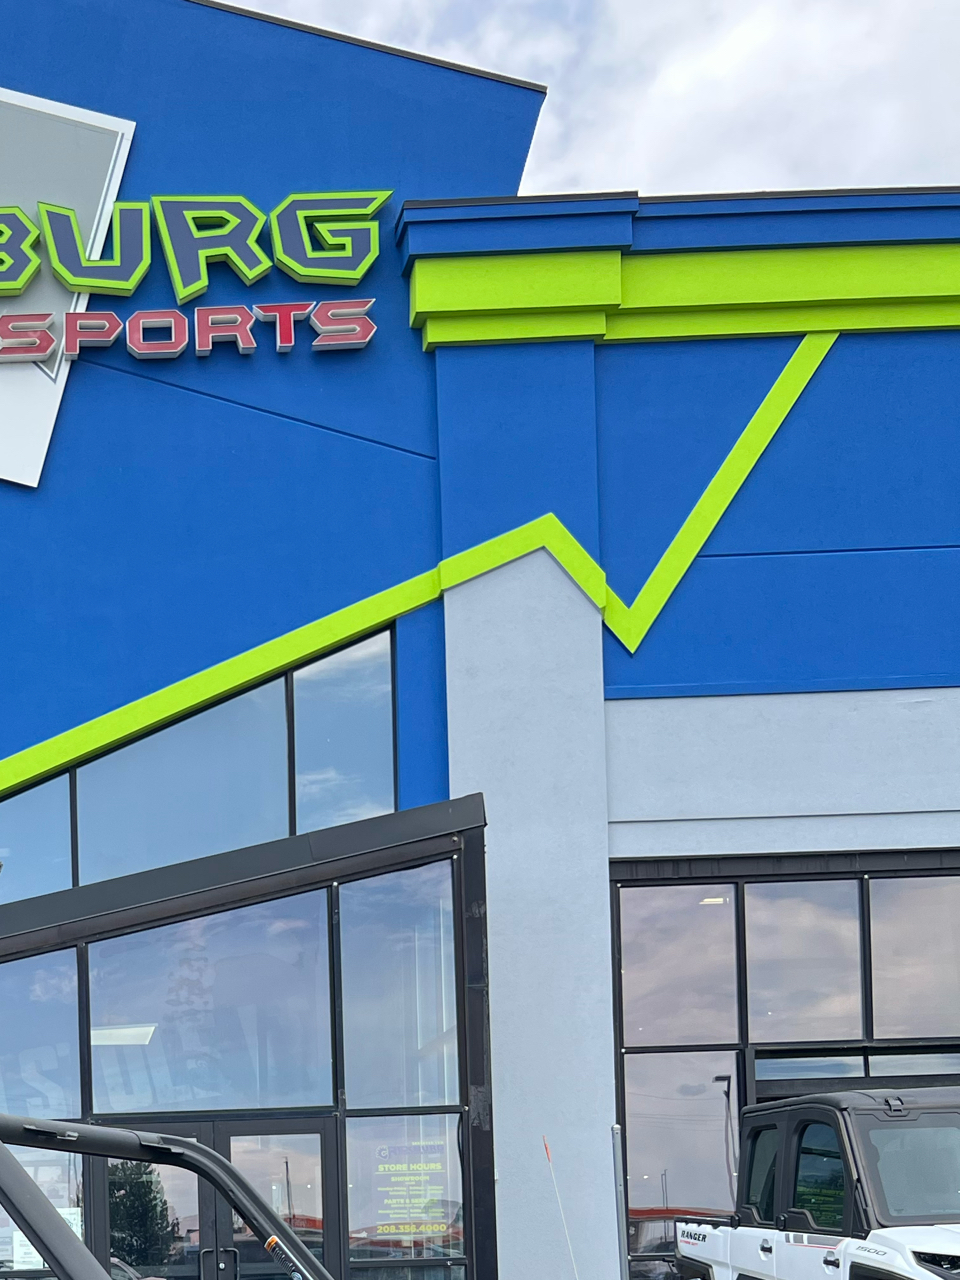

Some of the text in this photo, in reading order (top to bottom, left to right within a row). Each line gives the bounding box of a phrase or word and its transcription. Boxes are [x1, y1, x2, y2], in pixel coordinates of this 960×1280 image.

[378, 1163, 442, 1172] STORE HOURS
[376, 1224, 447, 1234] 208.356.4000
[681, 1230, 707, 1242] RANGER
[855, 1245, 887, 1256] 1500
